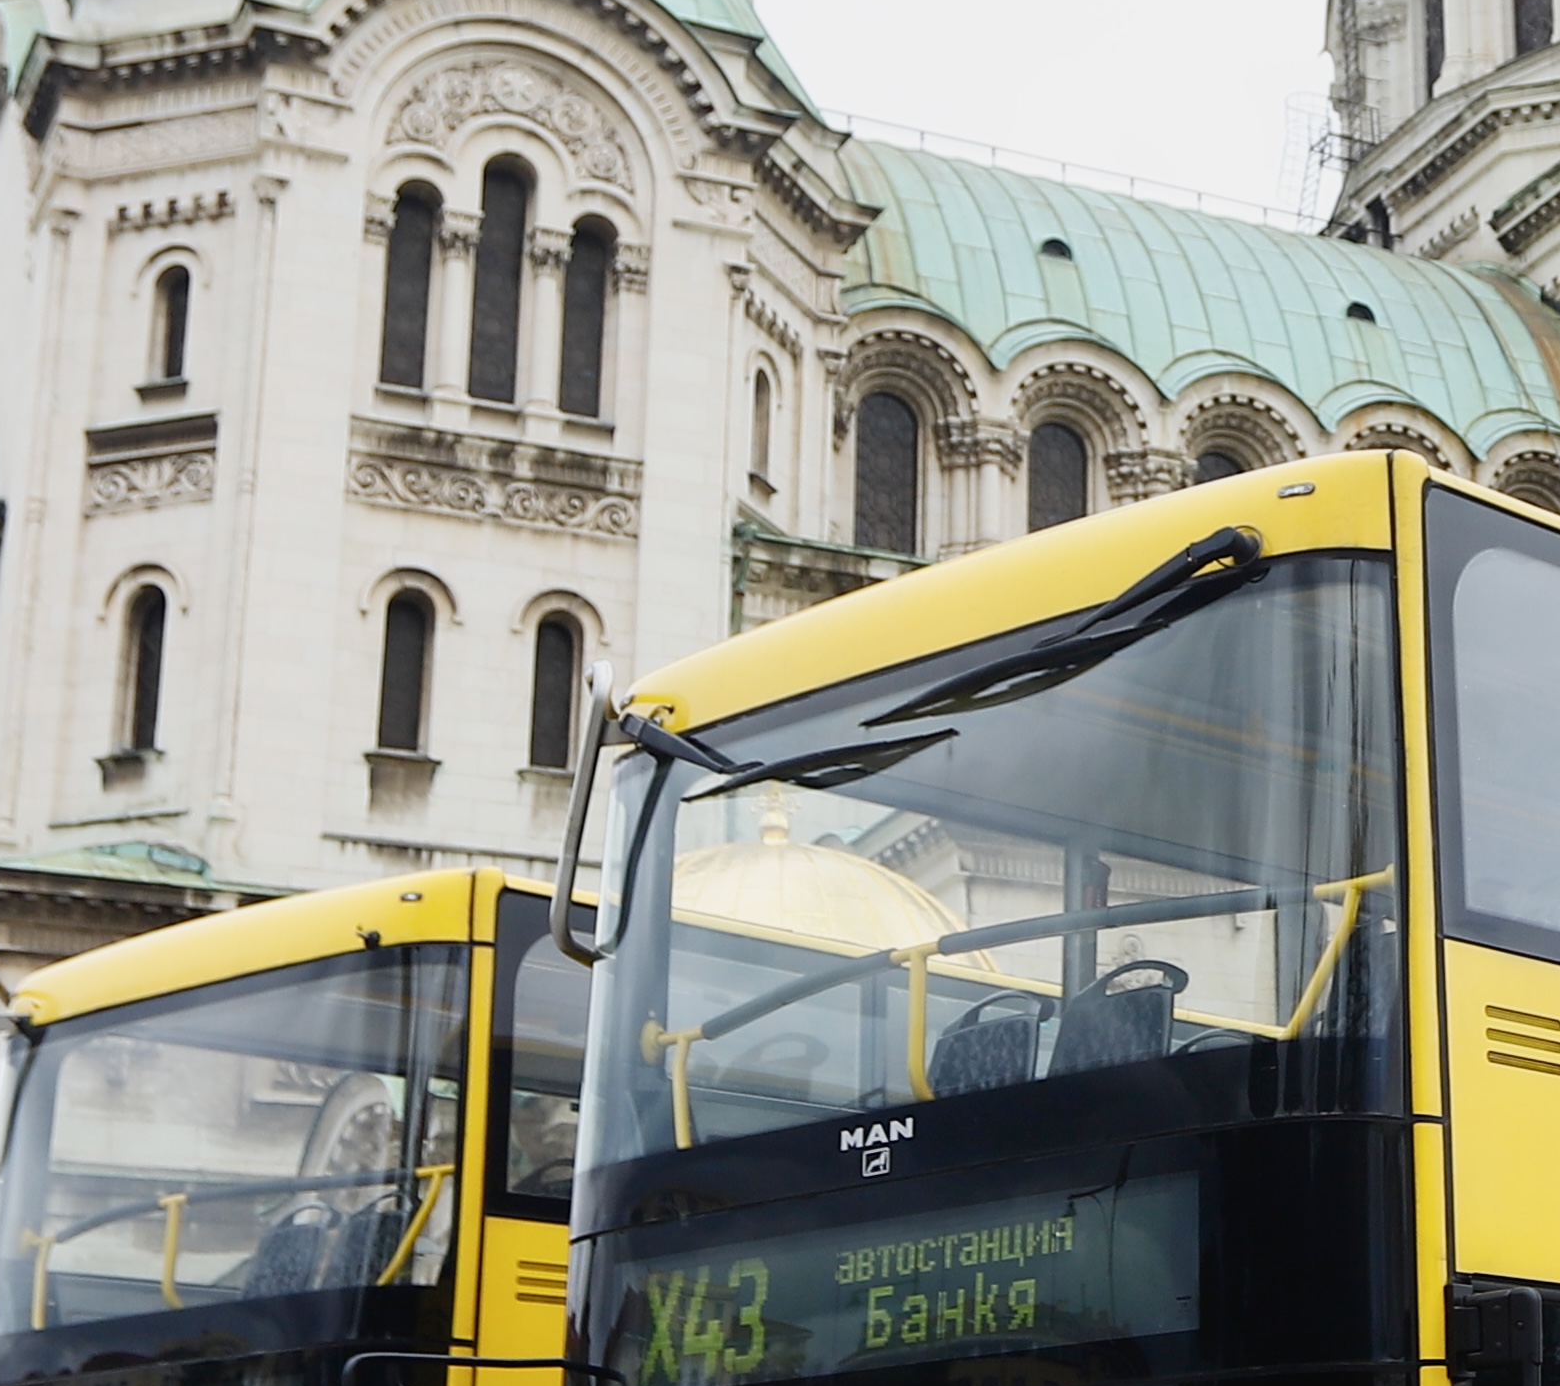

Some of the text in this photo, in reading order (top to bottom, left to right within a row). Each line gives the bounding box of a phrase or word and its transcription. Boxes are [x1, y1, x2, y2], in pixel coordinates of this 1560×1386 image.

[840, 1117, 915, 1151] MAN
[835, 1215, 1075, 1285] автостанция
[641, 1256, 770, 1386] X43
[866, 1271, 1037, 1349] Банкя
